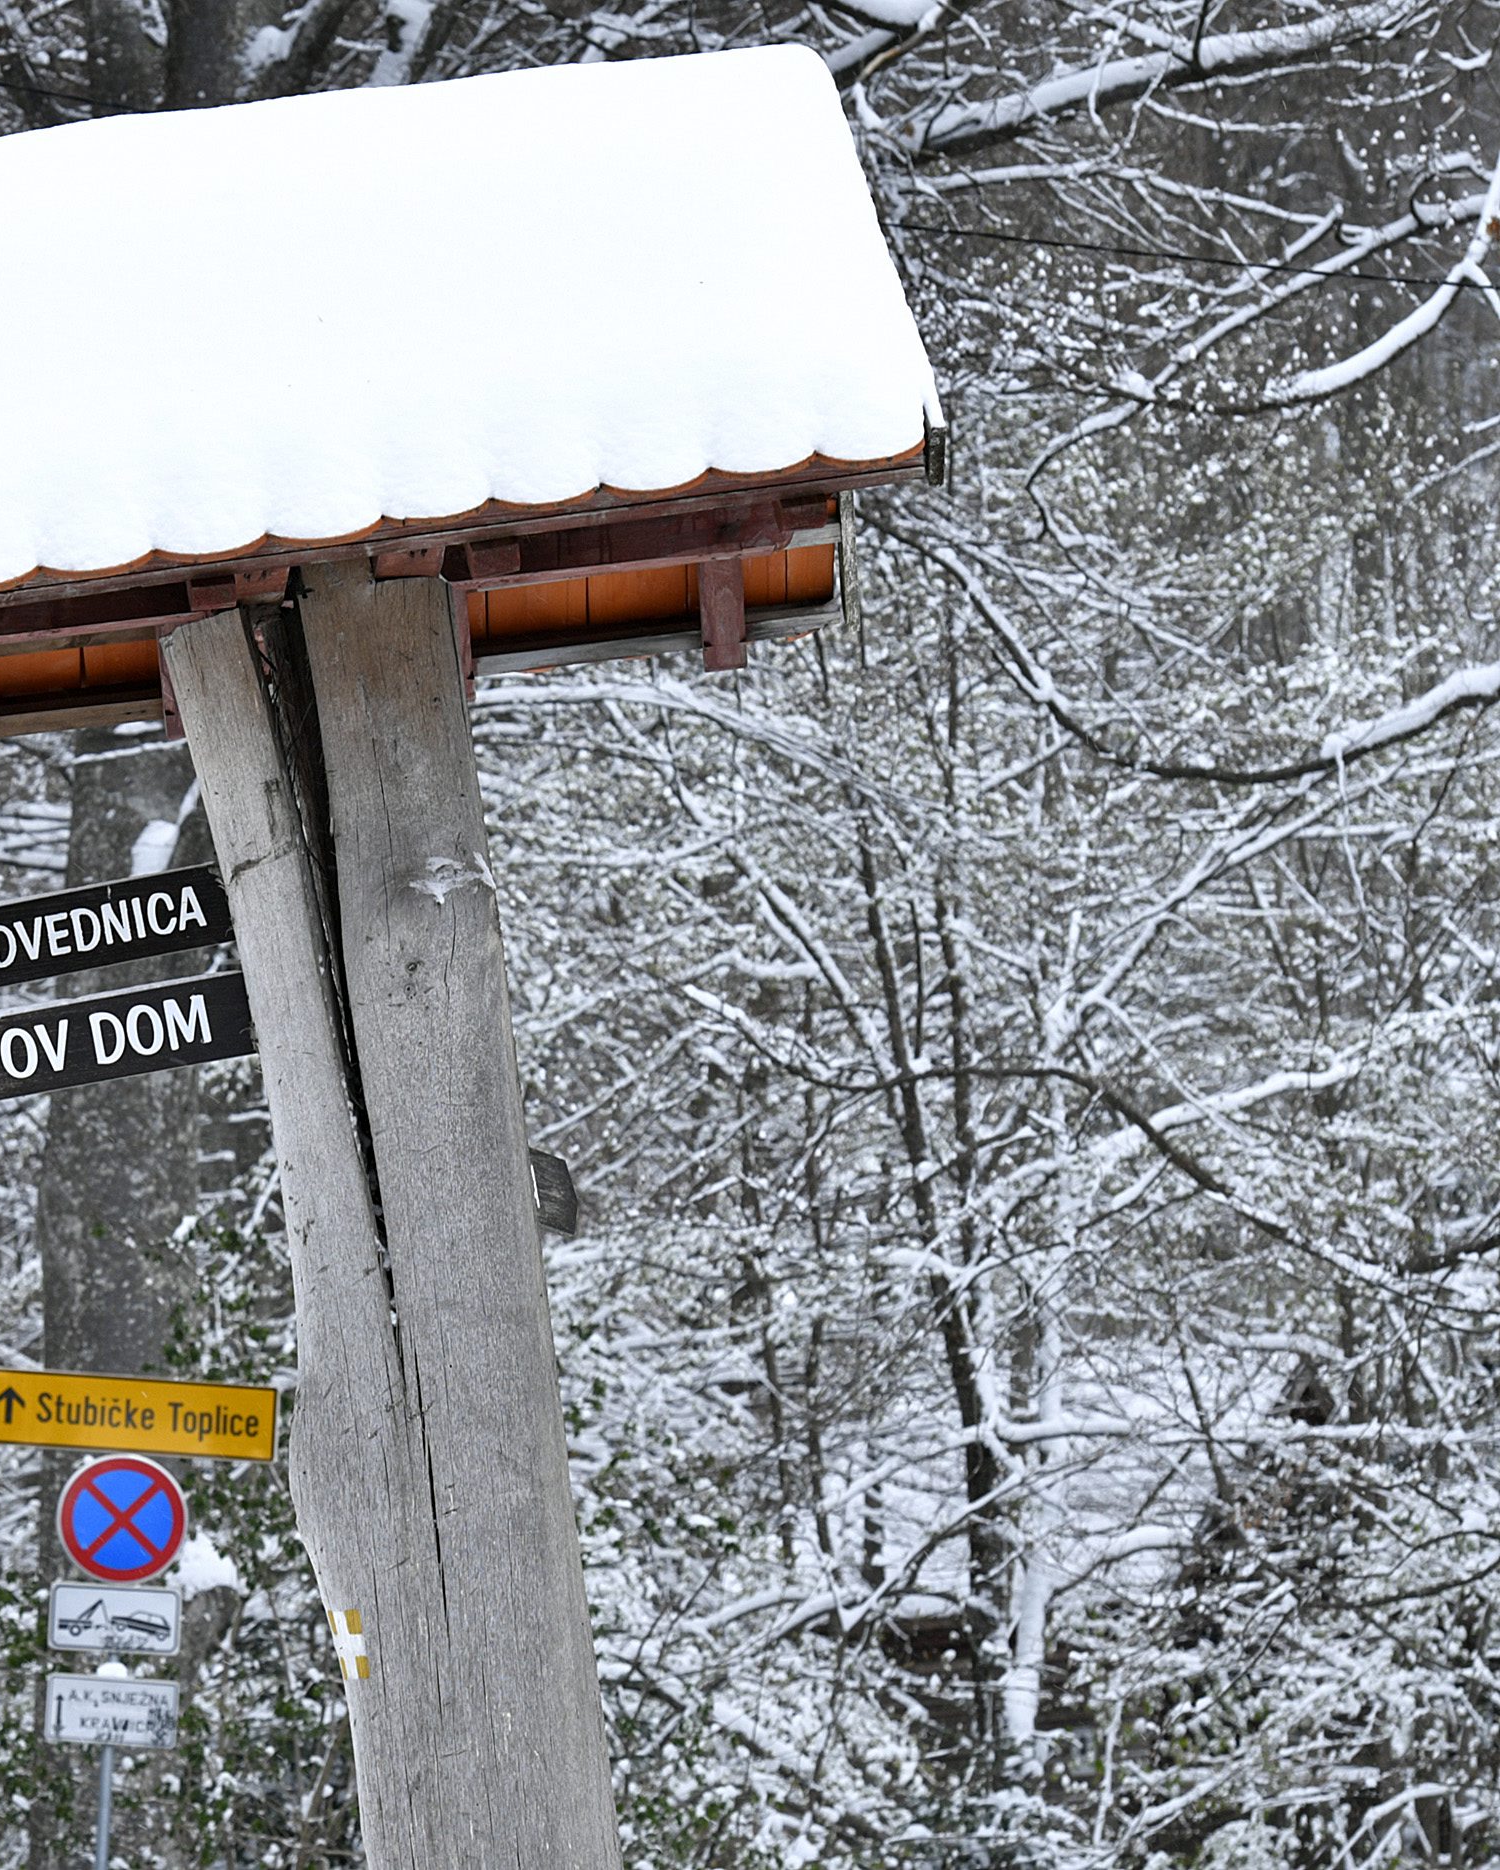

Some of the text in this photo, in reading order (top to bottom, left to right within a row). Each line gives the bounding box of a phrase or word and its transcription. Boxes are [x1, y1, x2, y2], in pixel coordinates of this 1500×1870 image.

[89, 993, 214, 1066] DOM
[36, 1392, 260, 1442] Stubičke Toplice
